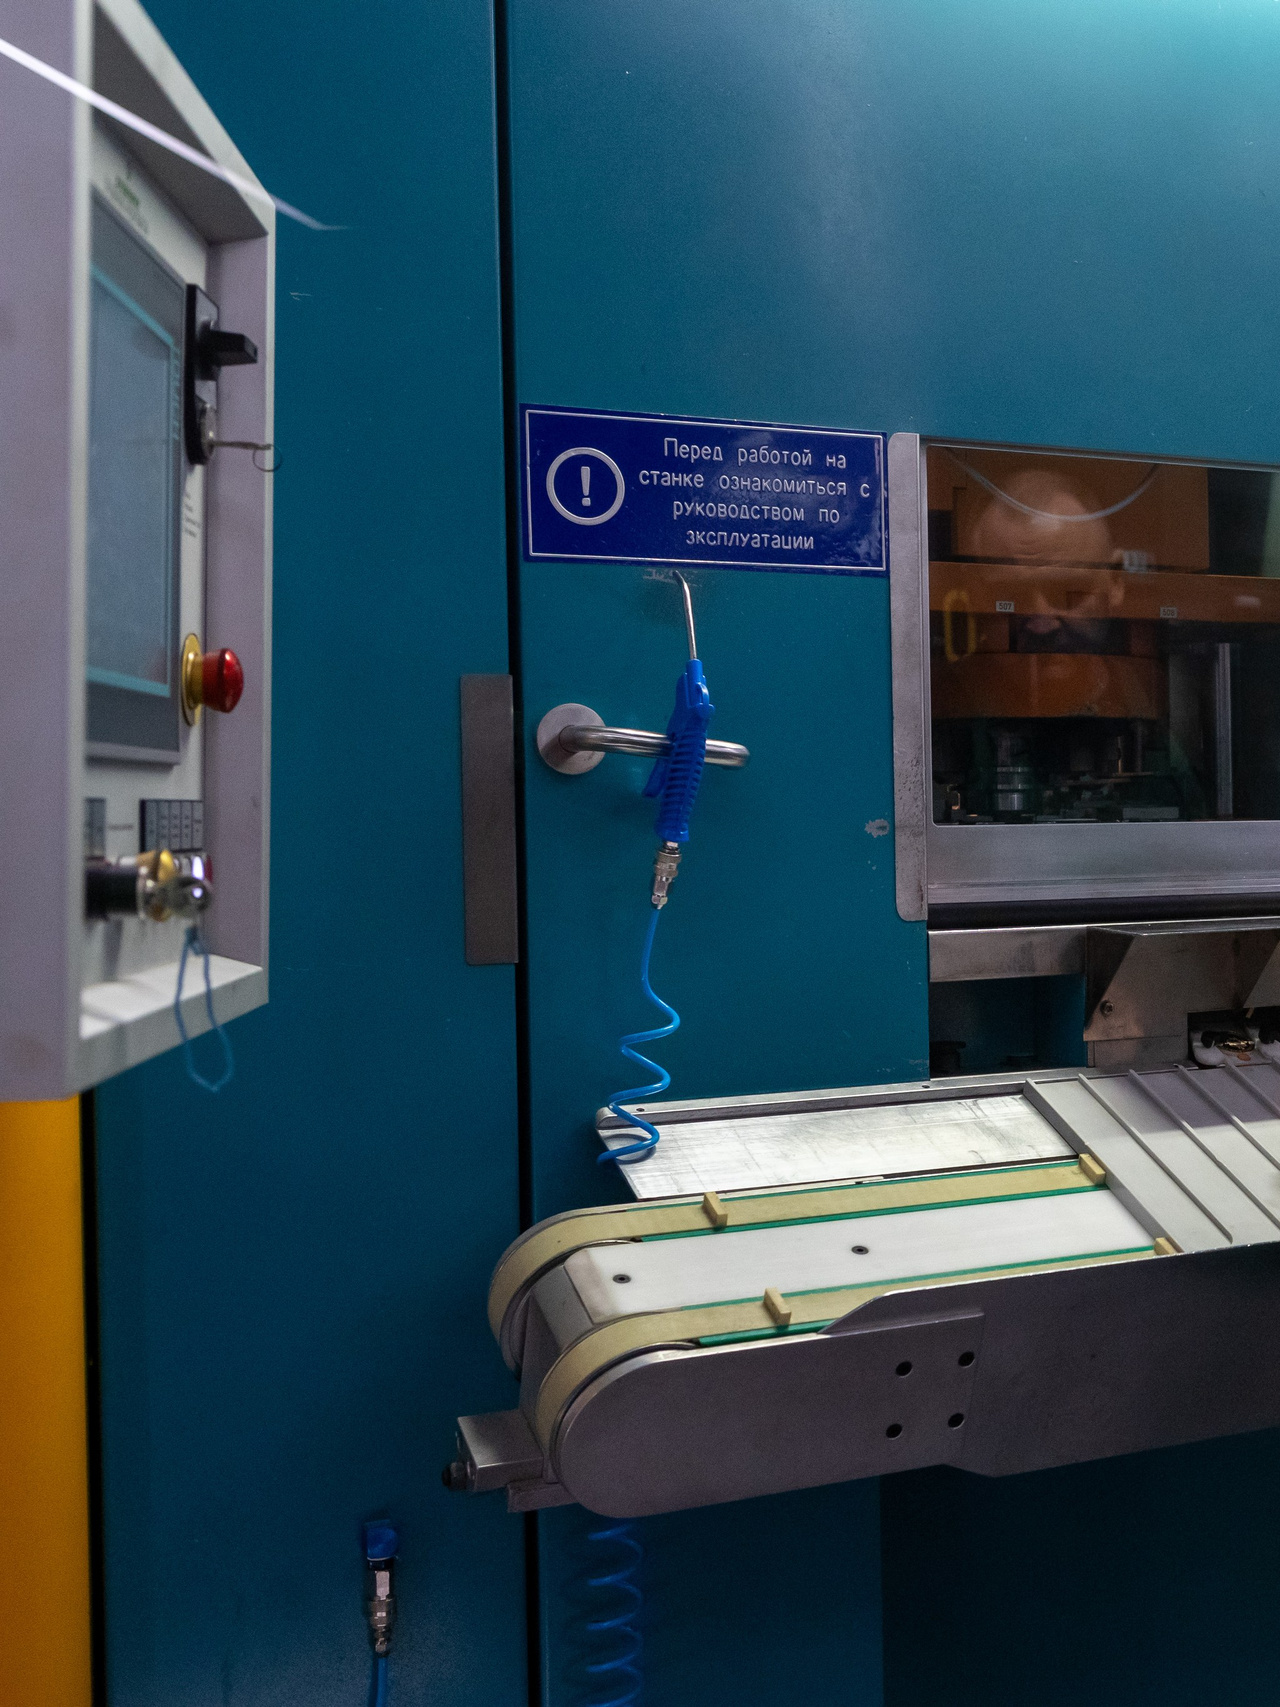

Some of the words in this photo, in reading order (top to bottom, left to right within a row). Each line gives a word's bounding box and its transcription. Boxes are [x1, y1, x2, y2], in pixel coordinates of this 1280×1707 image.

[663, 437, 723, 461] Перед
[737, 444, 812, 467] работой
[825, 454, 847, 469] на
[639, 470, 704, 489] станке
[718, 474, 847, 497] ознакомиться
[859, 482, 871, 498] с
[673, 500, 805, 522] руководством
[819, 508, 840, 524] по
